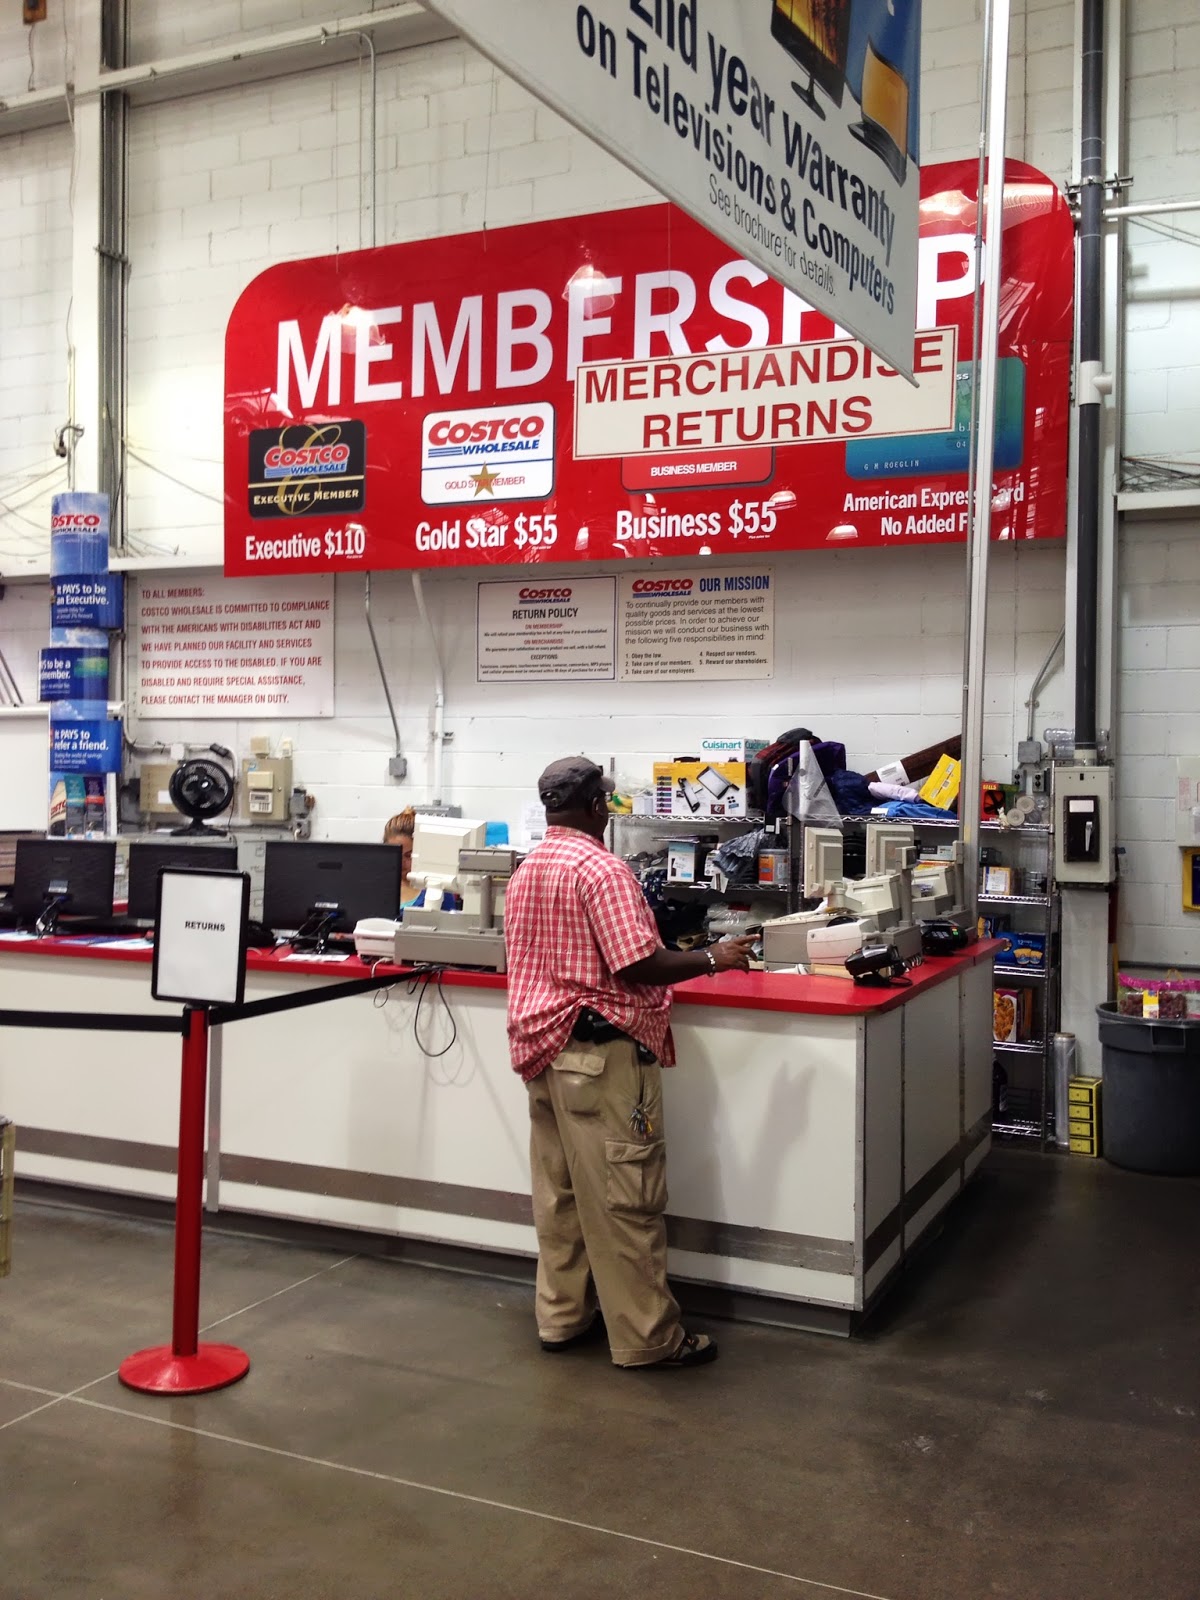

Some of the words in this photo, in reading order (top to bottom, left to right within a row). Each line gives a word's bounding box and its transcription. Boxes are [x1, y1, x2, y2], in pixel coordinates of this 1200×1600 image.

[707, 30, 775, 147] year
[783, 110, 896, 268] Warranty
[576, 5, 617, 79] on
[626, 27, 777, 215] Televisions
[781, 177, 798, 238] &
[803, 197, 895, 315] Computers
[709, 173, 731, 217] See
[734, 194, 782, 257] brochure
[783, 237, 797, 270] for
[800, 251, 836, 297] details.
[275, 234, 987, 410] MEMBERSP
[642, 396, 873, 449] RETURNS
[428, 416, 544, 446] COSTCO
[462, 440, 540, 455] WHOLESALE
[264, 444, 350, 468] COSTCO
[291, 463, 347, 475] WHOLESALE
[650, 464, 695, 477] BUSINESS
[696, 461, 737, 474] MEMBER
[884, 460, 920, 469] ROEGLIN
[445, 480, 468, 490] GOLD
[492, 476, 525, 487] MEMBER
[253, 492, 310, 505] EXECUTIVE
[314, 489, 359, 500] MEMBER
[843, 490, 917, 512] American
[616, 508, 721, 541] Business
[728, 499, 777, 539] $55
[881, 517, 903, 537] No
[905, 512, 956, 535] Added
[415, 519, 461, 552] Gold
[465, 517, 508, 549] Star
[514, 512, 558, 550] $55
[245, 532, 321, 561] Executive
[324, 528, 366, 560] $110
[62, 583, 80, 595] PAYS
[82, 584, 92, 594] to
[94, 583, 107, 595] be
[632, 578, 694, 593] COSTCO
[700, 577, 721, 592] OUR
[724, 575, 769, 591] MISSION
[142, 590, 151, 599] TO
[152, 589, 165, 599] ALL
[167, 587, 204, 598] MEMBERS:
[518, 587, 572, 599] COSTCO
[141, 606, 170, 617] COSTCO
[171, 605, 213, 616] WHOLESALE
[215, 604, 223, 614] IS
[224, 602, 268, 614] COMMITTED
[270, 602, 280, 612] TO
[281, 600, 330, 612] COMPLIANCE
[635, 600, 671, 609] continually
[673, 599, 699, 607] provide
[714, 597, 748, 605] members
[512, 609, 546, 620] RETURN
[548, 608, 578, 619] POLICY
[625, 611, 648, 619] quality
[650, 610, 671, 619] goods
[740, 605, 764, 613] lowest
[141, 624, 160, 635] WITH
[161, 624, 174, 634] THE
[176, 623, 218, 633] AMERICANS
[219, 622, 239, 632] WITH
[240, 620, 287, 632] DISABILITIES
[288, 619, 303, 630] ACT
[304, 619, 321, 629] AND
[625, 619, 654, 627] possible
[678, 626, 705, 634] conduct
[141, 642, 152, 652] WE
[154, 642, 172, 651] HAVE
[174, 641, 207, 651] PLANNED
[208, 640, 224, 650] OUR
[225, 639, 257, 650] FACILITY
[259, 639, 274, 649] AND
[276, 638, 313, 648] SERVICES
[637, 636, 668, 645] following
[683, 634, 736, 643] responsibilities
[141, 660, 151, 669] TO
[152, 660, 182, 669] PROVIDE
[184, 659, 212, 669] ACCESS
[214, 659, 223, 668] TO
[225, 658, 238, 668] THE
[280, 657, 287, 667] IF
[289, 657, 305, 667] YOU
[306, 656, 322, 666] ARE
[141, 678, 175, 687] DISABLED
[176, 677, 192, 687] AND
[193, 677, 224, 686] REQUIRE
[226, 676, 255, 686] SPECIAL
[257, 675, 306, 687] ASSISTANCE,
[141, 695, 166, 705] PLEASE
[168, 695, 200, 704] CONTACT
[202, 695, 215, 704] THE
[217, 694, 253, 704] MANAGER
[254, 694, 266, 704] ON
[267, 694, 289, 704] DUTY.
[60, 729, 79, 740] PAYS
[80, 730, 91, 740] to
[54, 740, 71, 751] refer
[71, 742, 78, 750] a
[79, 739, 109, 751] friend.
[702, 740, 742, 749] Cuisinart
[184, 920, 226, 932] RETURNS
